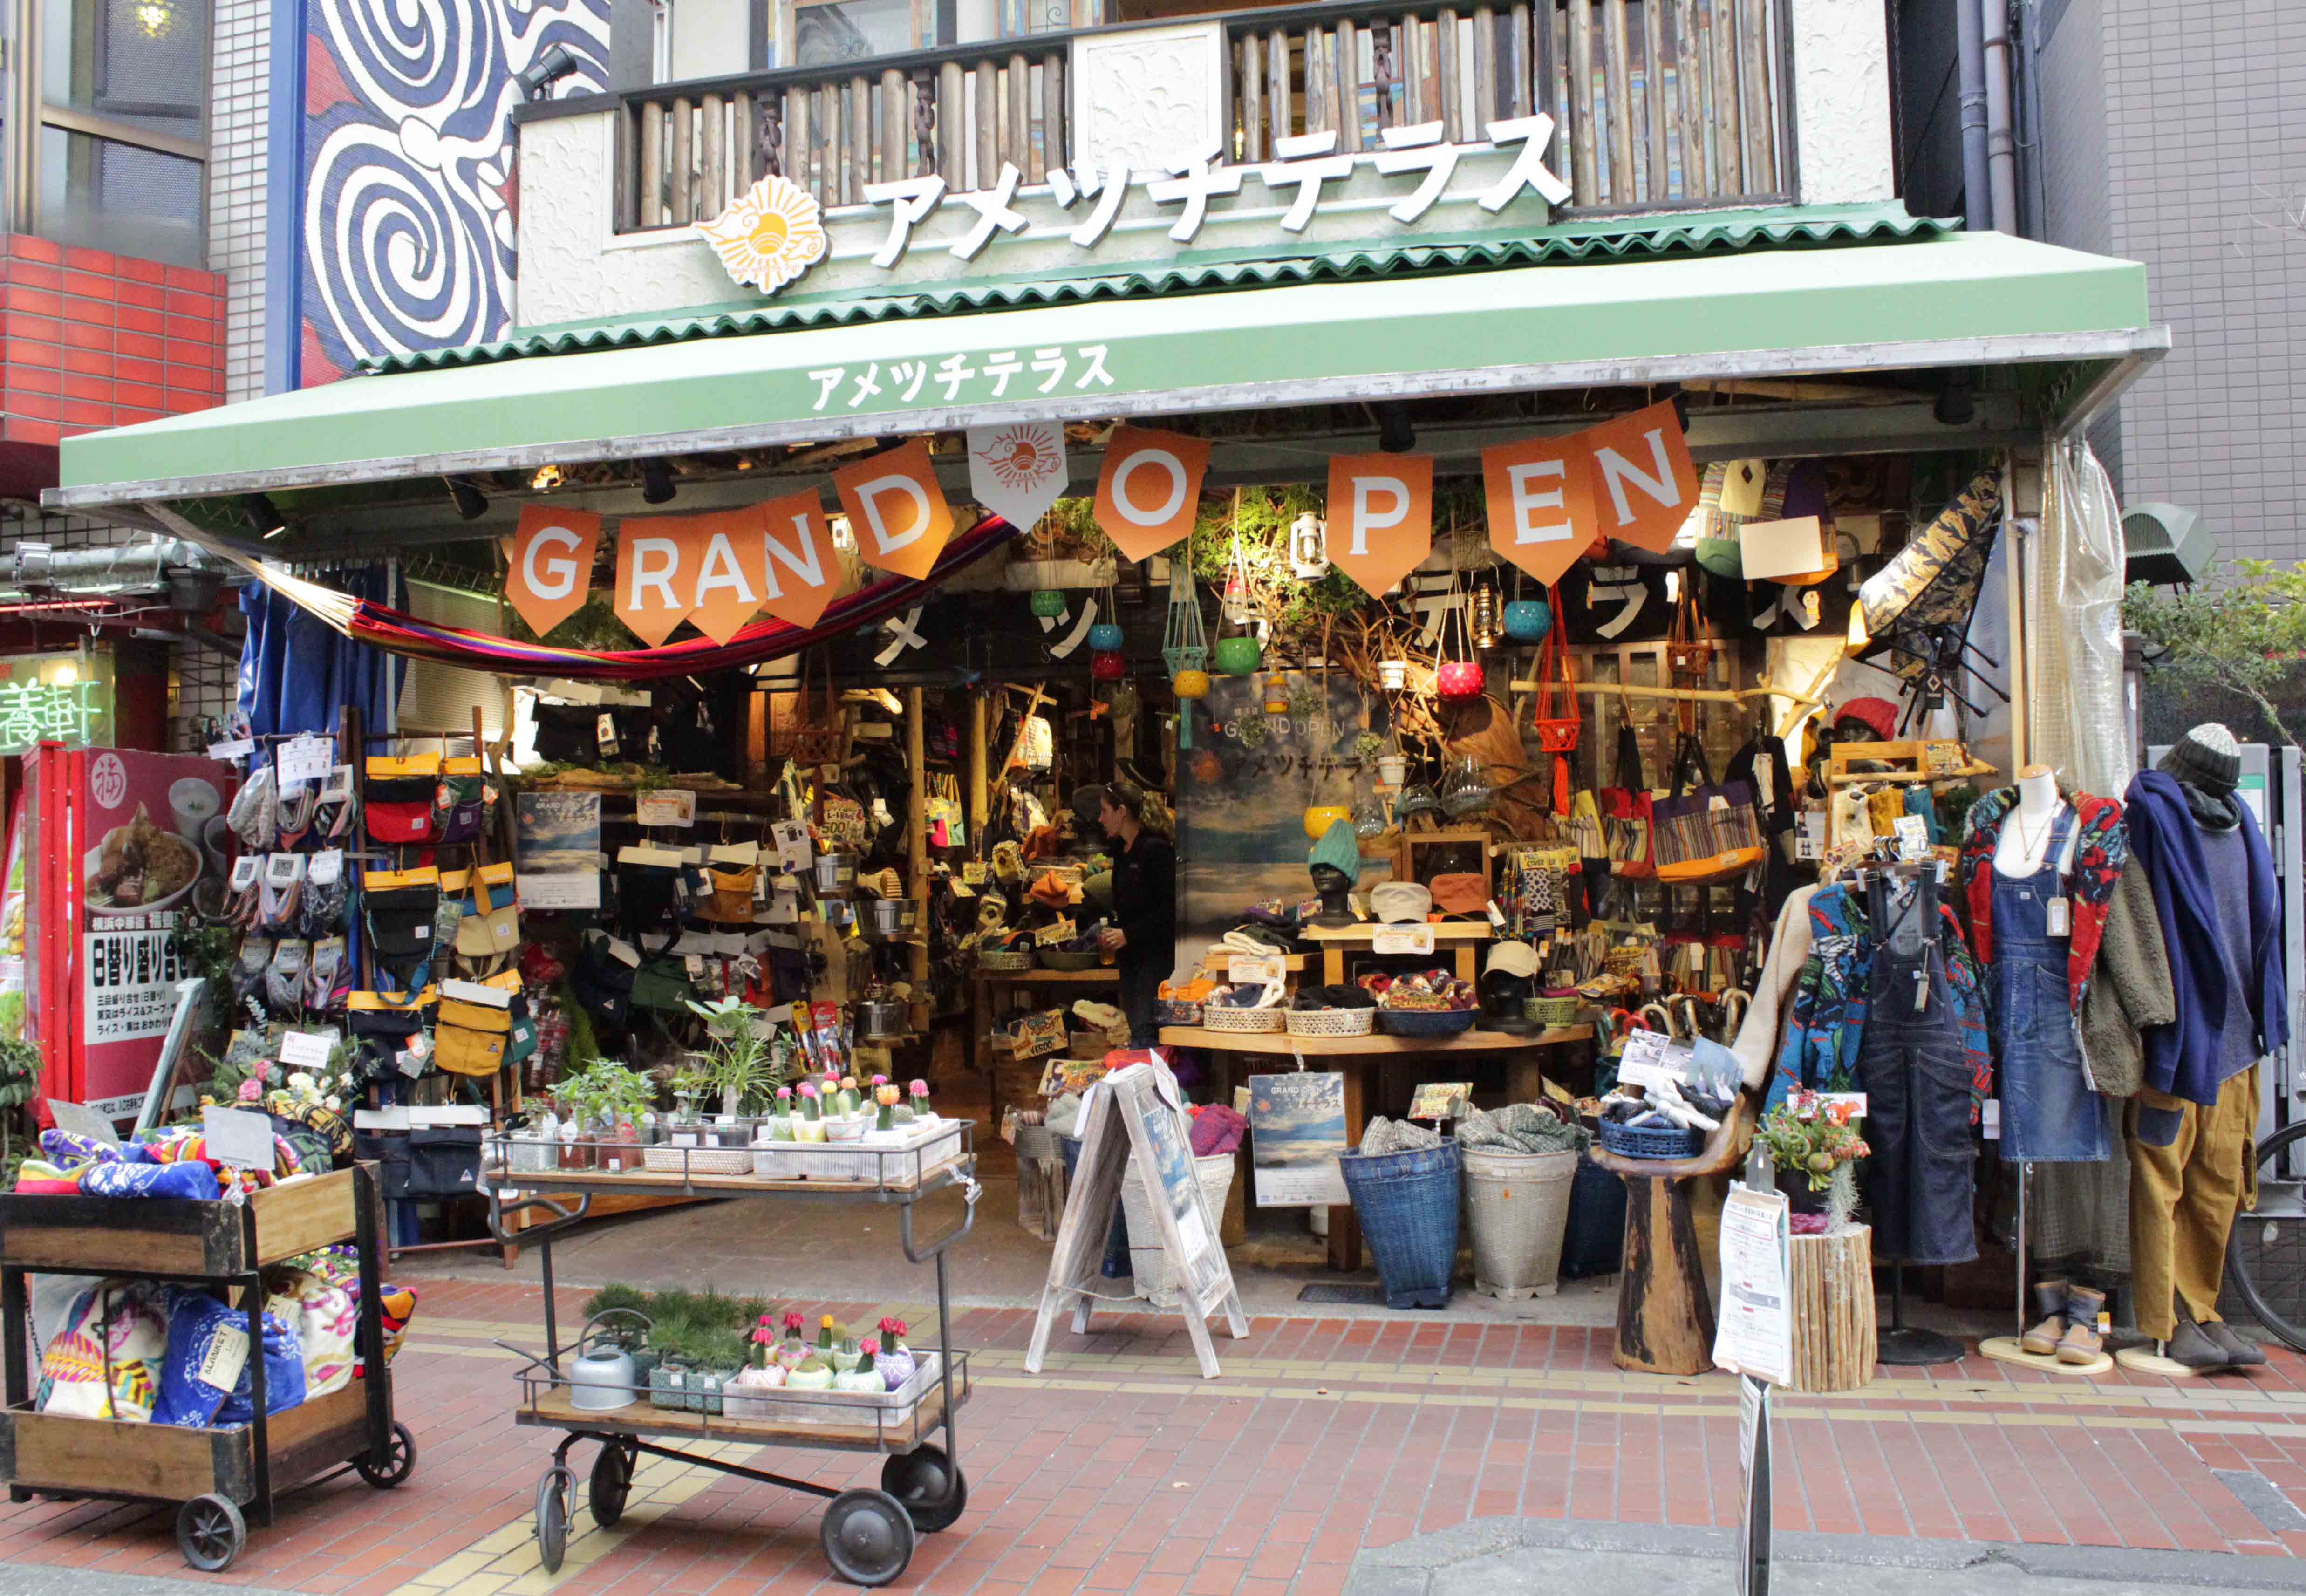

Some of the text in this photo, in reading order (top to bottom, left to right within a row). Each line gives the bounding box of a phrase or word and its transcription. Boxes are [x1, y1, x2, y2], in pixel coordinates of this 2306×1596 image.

[862, 111, 1572, 269] アメツチテラス
[808, 344, 1115, 411] アメツチテラス
[523, 428, 1681, 611] GRAND OPEN
